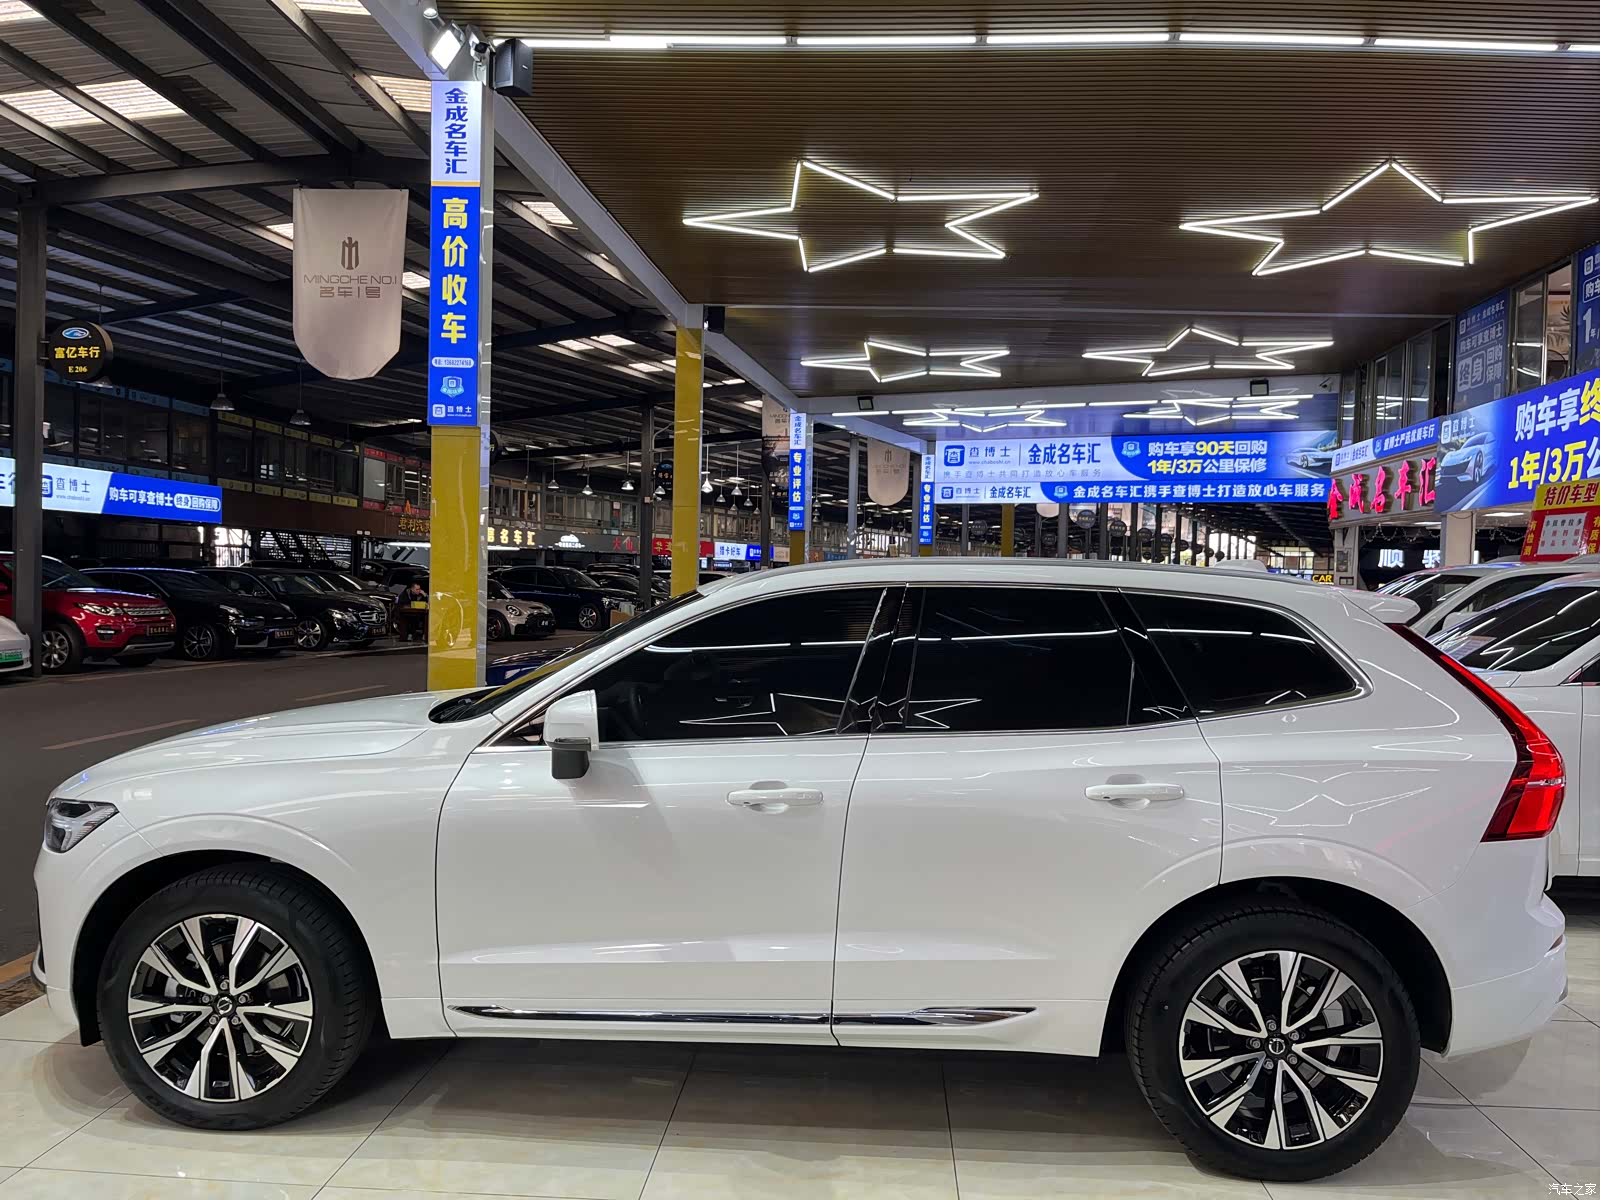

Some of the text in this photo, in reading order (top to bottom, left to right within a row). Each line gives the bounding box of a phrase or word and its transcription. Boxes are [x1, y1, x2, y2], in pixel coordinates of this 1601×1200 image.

[444, 87, 469, 175] 金成名车汇
[441, 197, 469, 344] 高价收车
[303, 275, 368, 285] MINGCHE
[54, 345, 101, 359] 富亿车行
[75, 365, 88, 373] 206
[1027, 442, 1102, 465] 金成名车汇
[1147, 439, 1268, 458] 购车享90天回购
[943, 468, 1103, 480] 携手查博士共同打造放心车服务
[1147, 457, 1268, 475] 1年/3万公里保修
[56, 477, 91, 493] 查博士
[792, 452, 803, 503] 专业评估
[989, 485, 1032, 499] 金成名车汇
[1073, 483, 1326, 499] 金成名车汇携手查博士打造放心车服务
[1327, 456, 1437, 520] 金成名车汇
[1544, 481, 1600, 507] 特价车型
[922, 484, 932, 524] 专业评估
[1312, 574, 1333, 583] CAR
